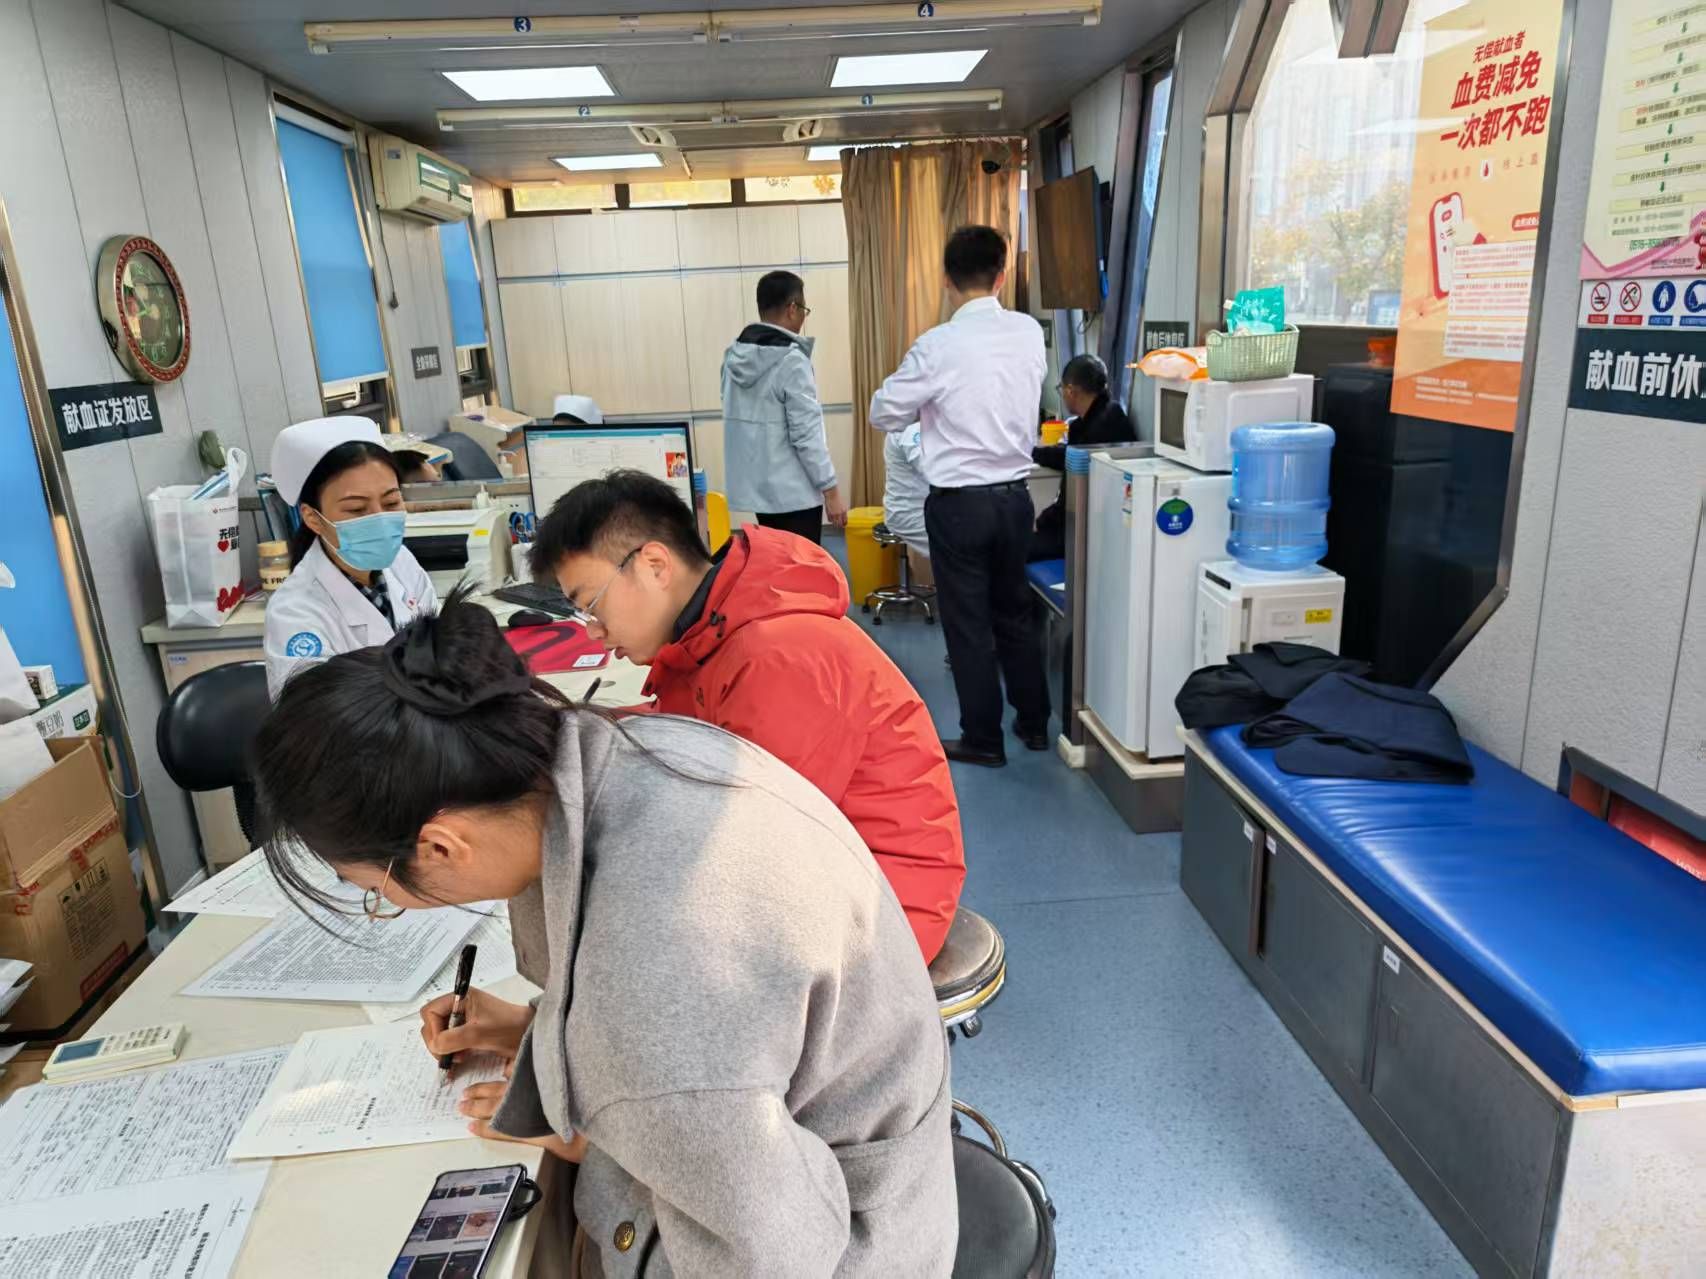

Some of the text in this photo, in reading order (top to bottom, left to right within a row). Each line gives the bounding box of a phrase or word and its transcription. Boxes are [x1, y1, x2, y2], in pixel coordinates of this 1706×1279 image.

[518, 17, 528, 32] 3
[920, 4, 930, 16] 4
[1473, 30, 1526, 63] 无偿献血者
[1450, 50, 1542, 110] 血费减免
[580, 106, 588, 117] 2
[1440, 94, 1551, 151] 一次都不跑
[1585, 349, 1706, 399] 献血前休
[61, 395, 153, 435] 献血证发放区
